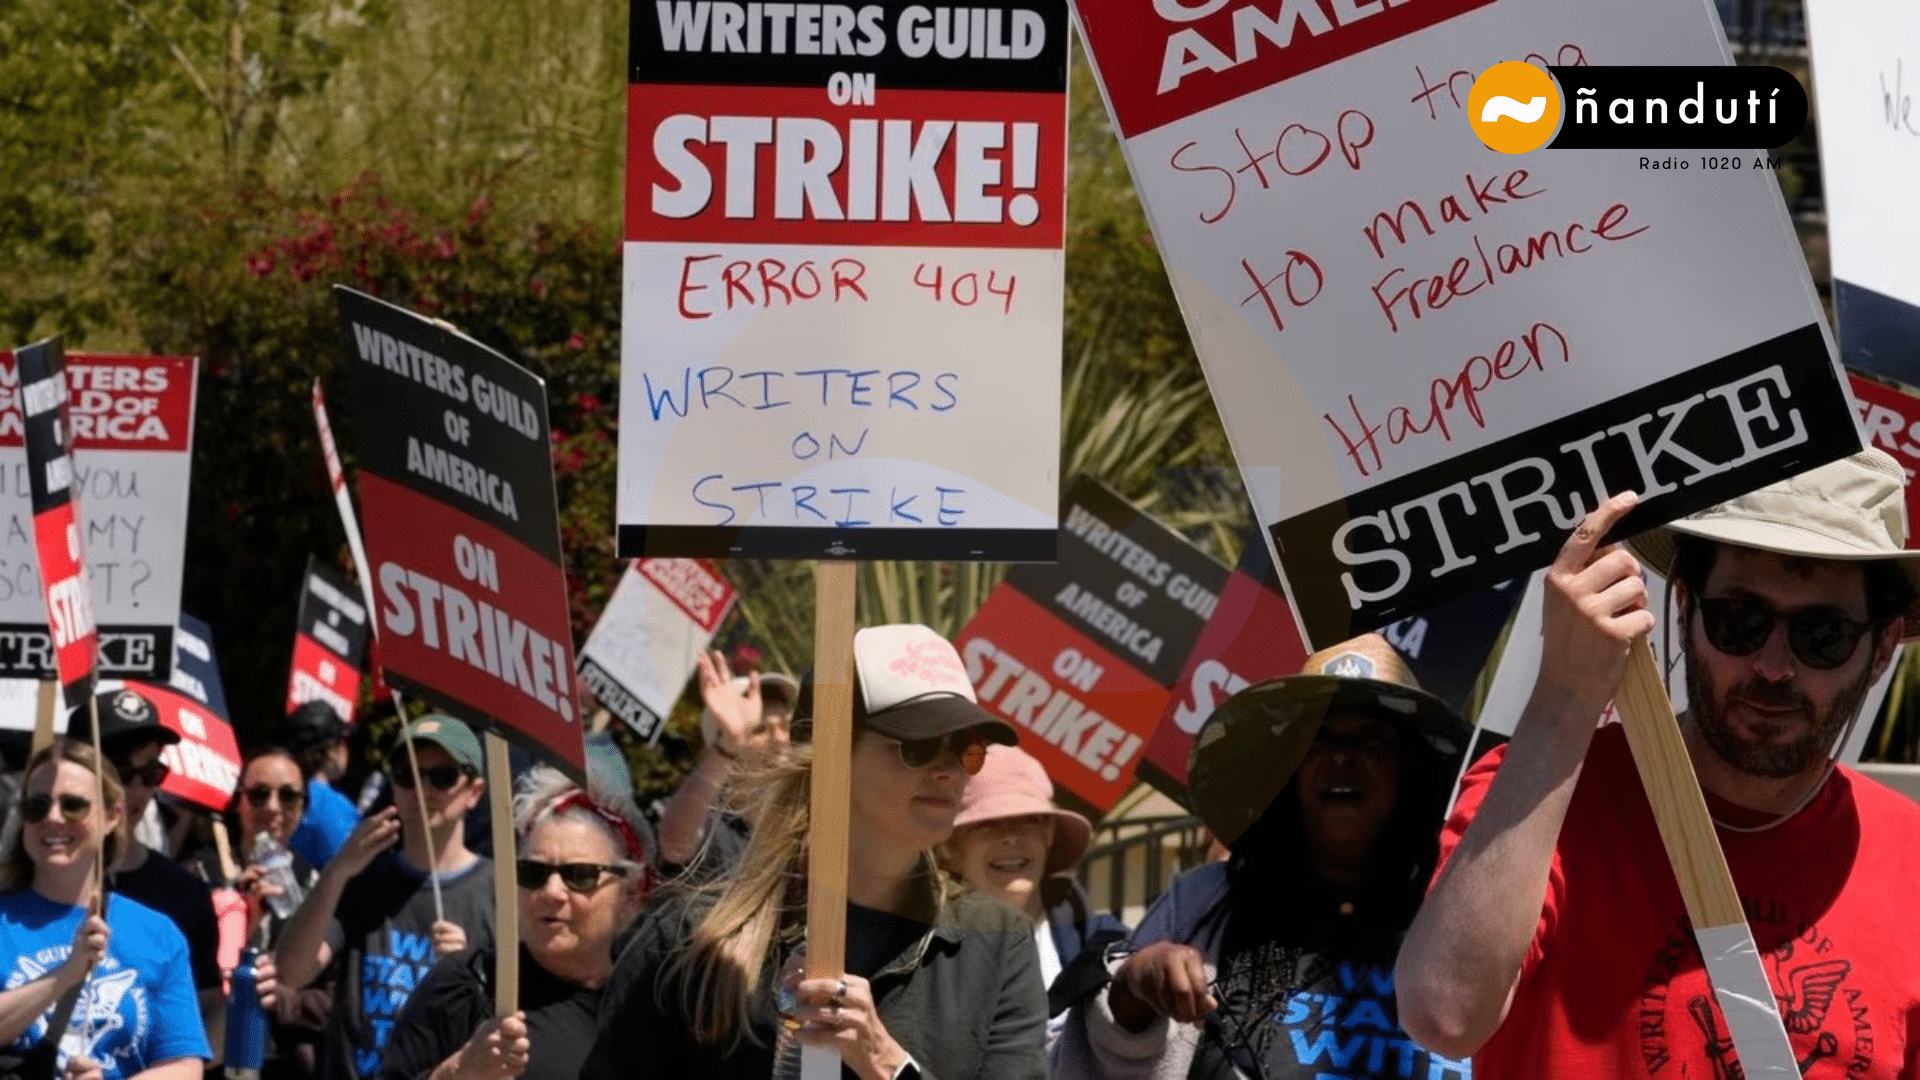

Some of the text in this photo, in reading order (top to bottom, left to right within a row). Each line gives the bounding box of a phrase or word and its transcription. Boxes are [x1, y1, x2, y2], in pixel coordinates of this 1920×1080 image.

[655, 0, 1046, 60] WRITERS GUILD
[827, 72, 875, 107] ON
[651, 114, 1040, 226] STRIKE!
[1170, 110, 1374, 223] Stop
[678, 254, 1016, 319] ERROR 404
[1241, 169, 1547, 332] to make
[1372, 203, 1650, 333] Freelance
[114, 396, 160, 415] OF
[353, 321, 540, 441] WRITERS GUILD
[644, 367, 958, 421] WRITERS
[1325, 323, 1569, 477] Happen
[443, 409, 471, 447] OF
[791, 428, 869, 460] ON
[407, 435, 519, 522] AMERICA
[693, 474, 965, 529] STRIKE
[1331, 364, 1808, 610] STRIKE
[89, 515, 145, 553] MY
[453, 534, 499, 594] ON
[1064, 503, 1172, 587] WRITERS
[1054, 582, 1164, 664] AMERICA
[1115, 581, 1148, 609] OF
[379, 561, 574, 723] STRIKE!
[1052, 648, 1105, 693] ON
[963, 638, 1143, 782] STRIKE!
